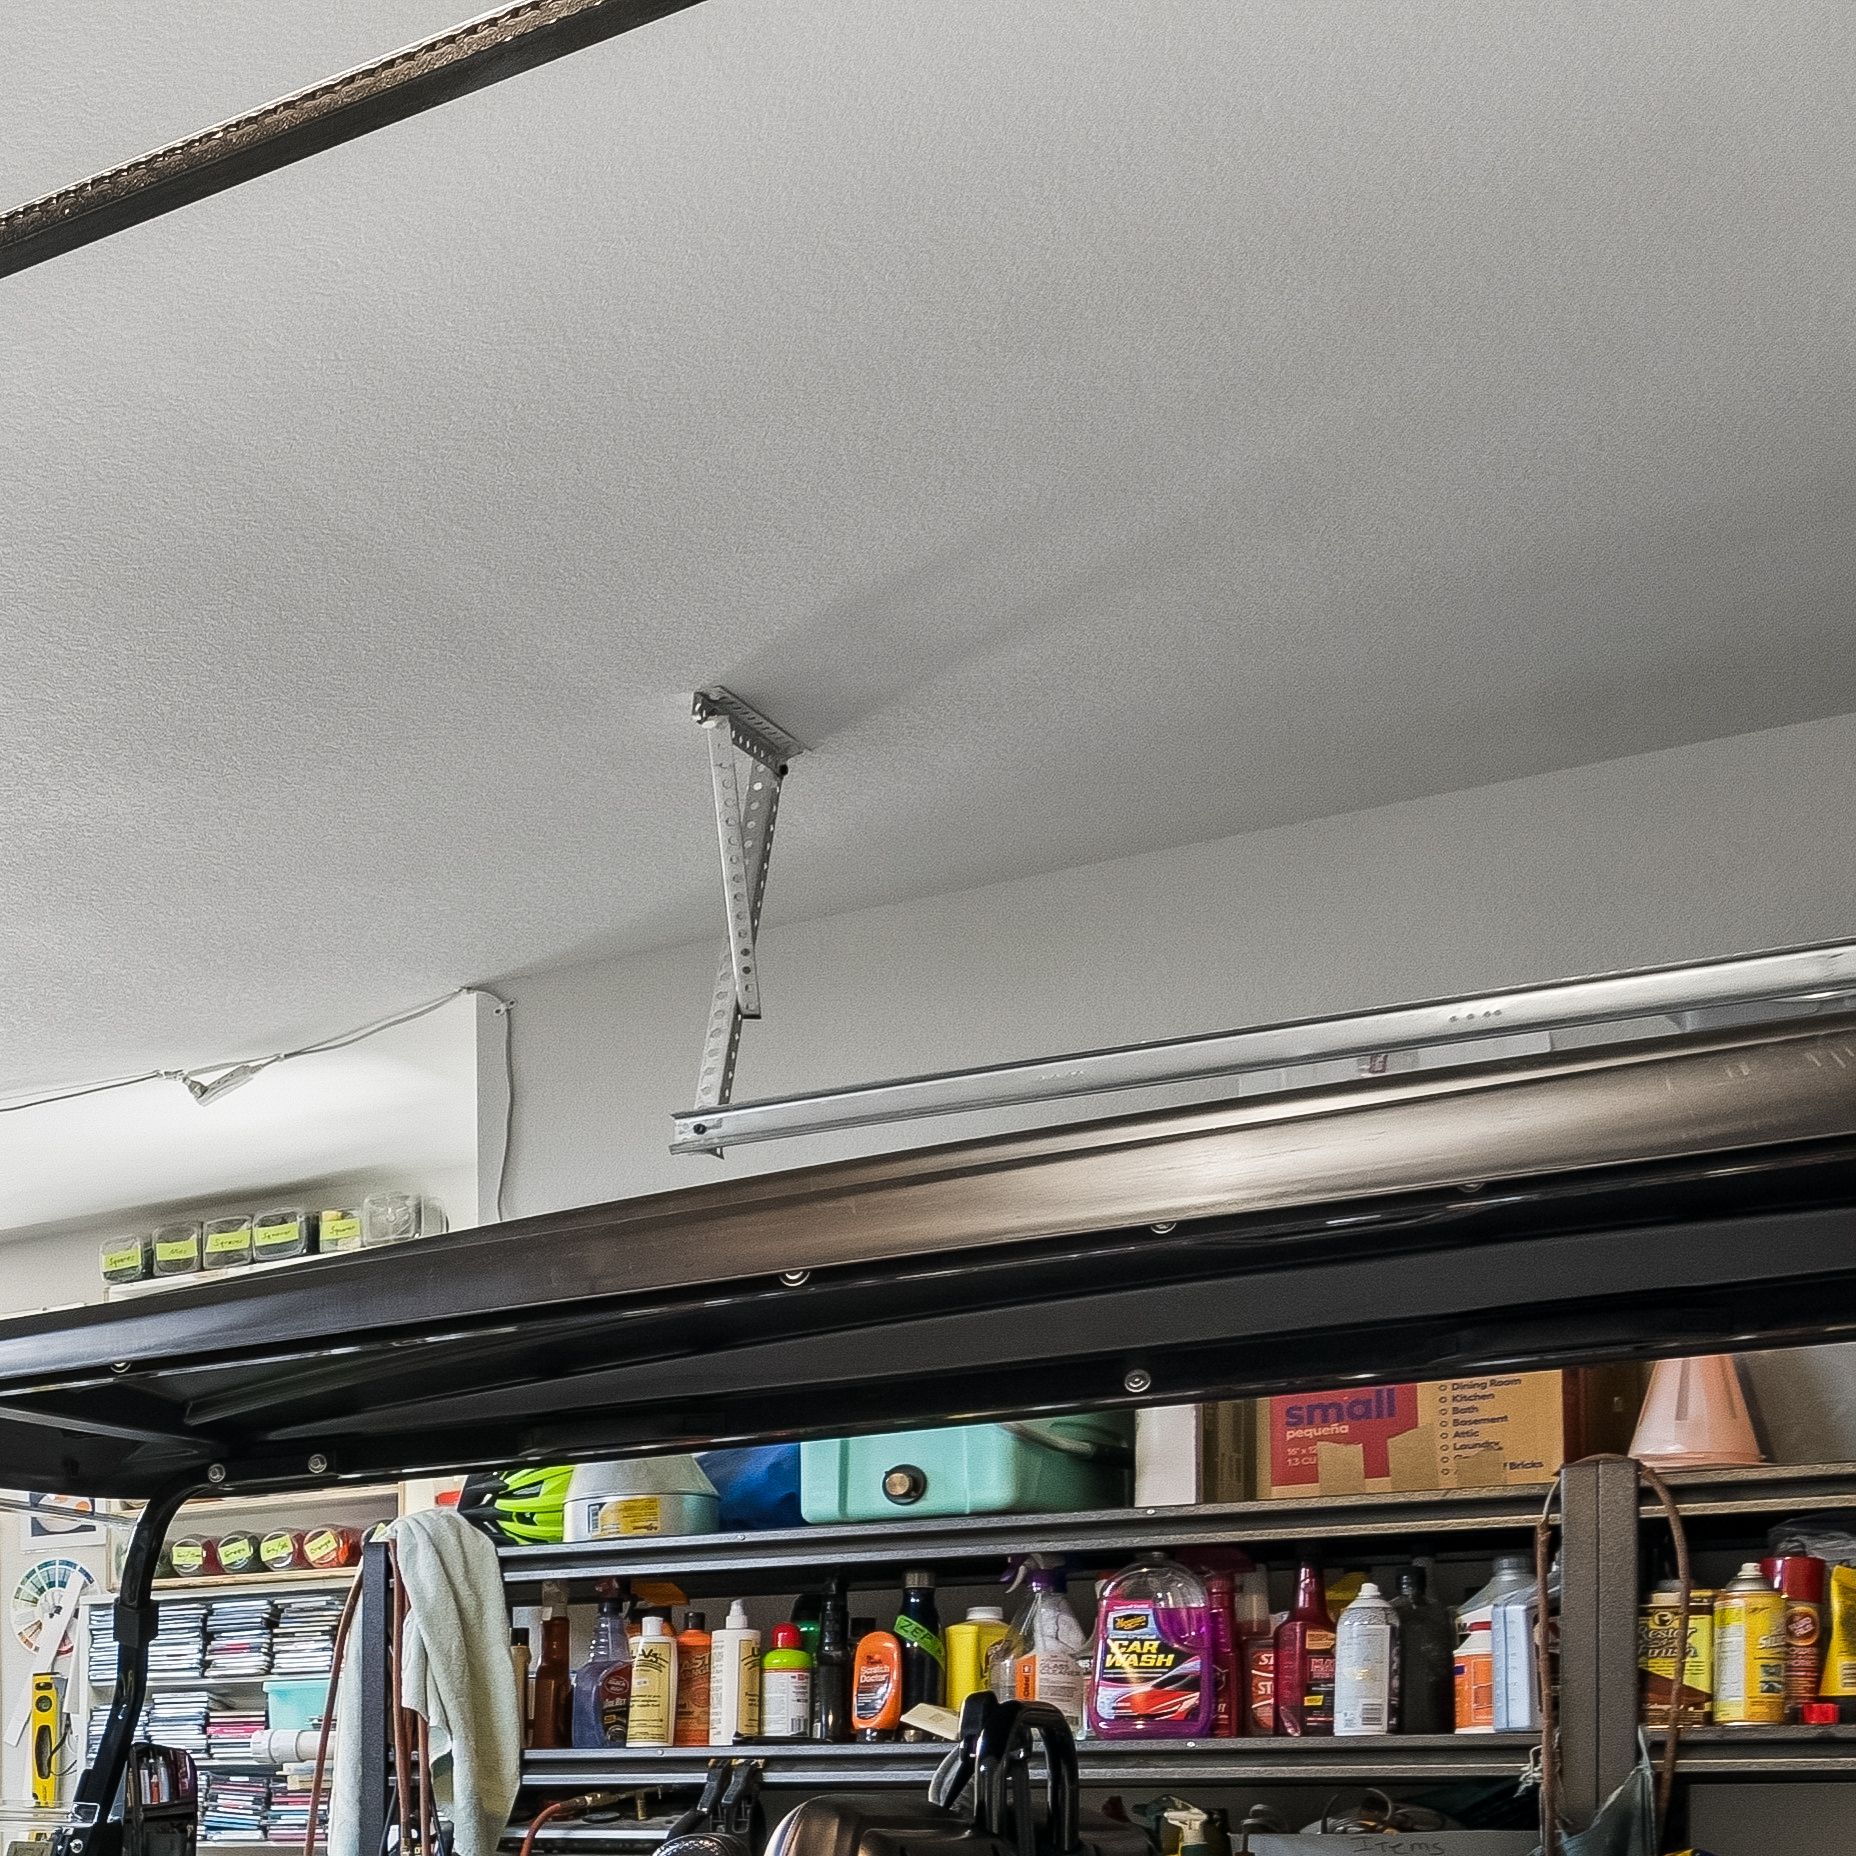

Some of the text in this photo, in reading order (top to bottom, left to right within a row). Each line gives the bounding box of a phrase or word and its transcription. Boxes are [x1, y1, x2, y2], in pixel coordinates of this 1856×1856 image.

[1451, 1379, 1522, 1391] Dining Room
[1452, 1393, 1495, 1403] Kitchen
[1285, 1387, 1396, 1427] small
[1452, 1405, 1479, 1415] Bath
[1452, 1415, 1508, 1427] Basement
[1286, 1423, 1349, 1440] pequeña
[1453, 1428, 1479, 1438] Attic
[1509, 1460, 1544, 1470] Bricks
[1114, 1640, 1161, 1653] CAR
[1104, 1654, 1175, 1667] WASH
